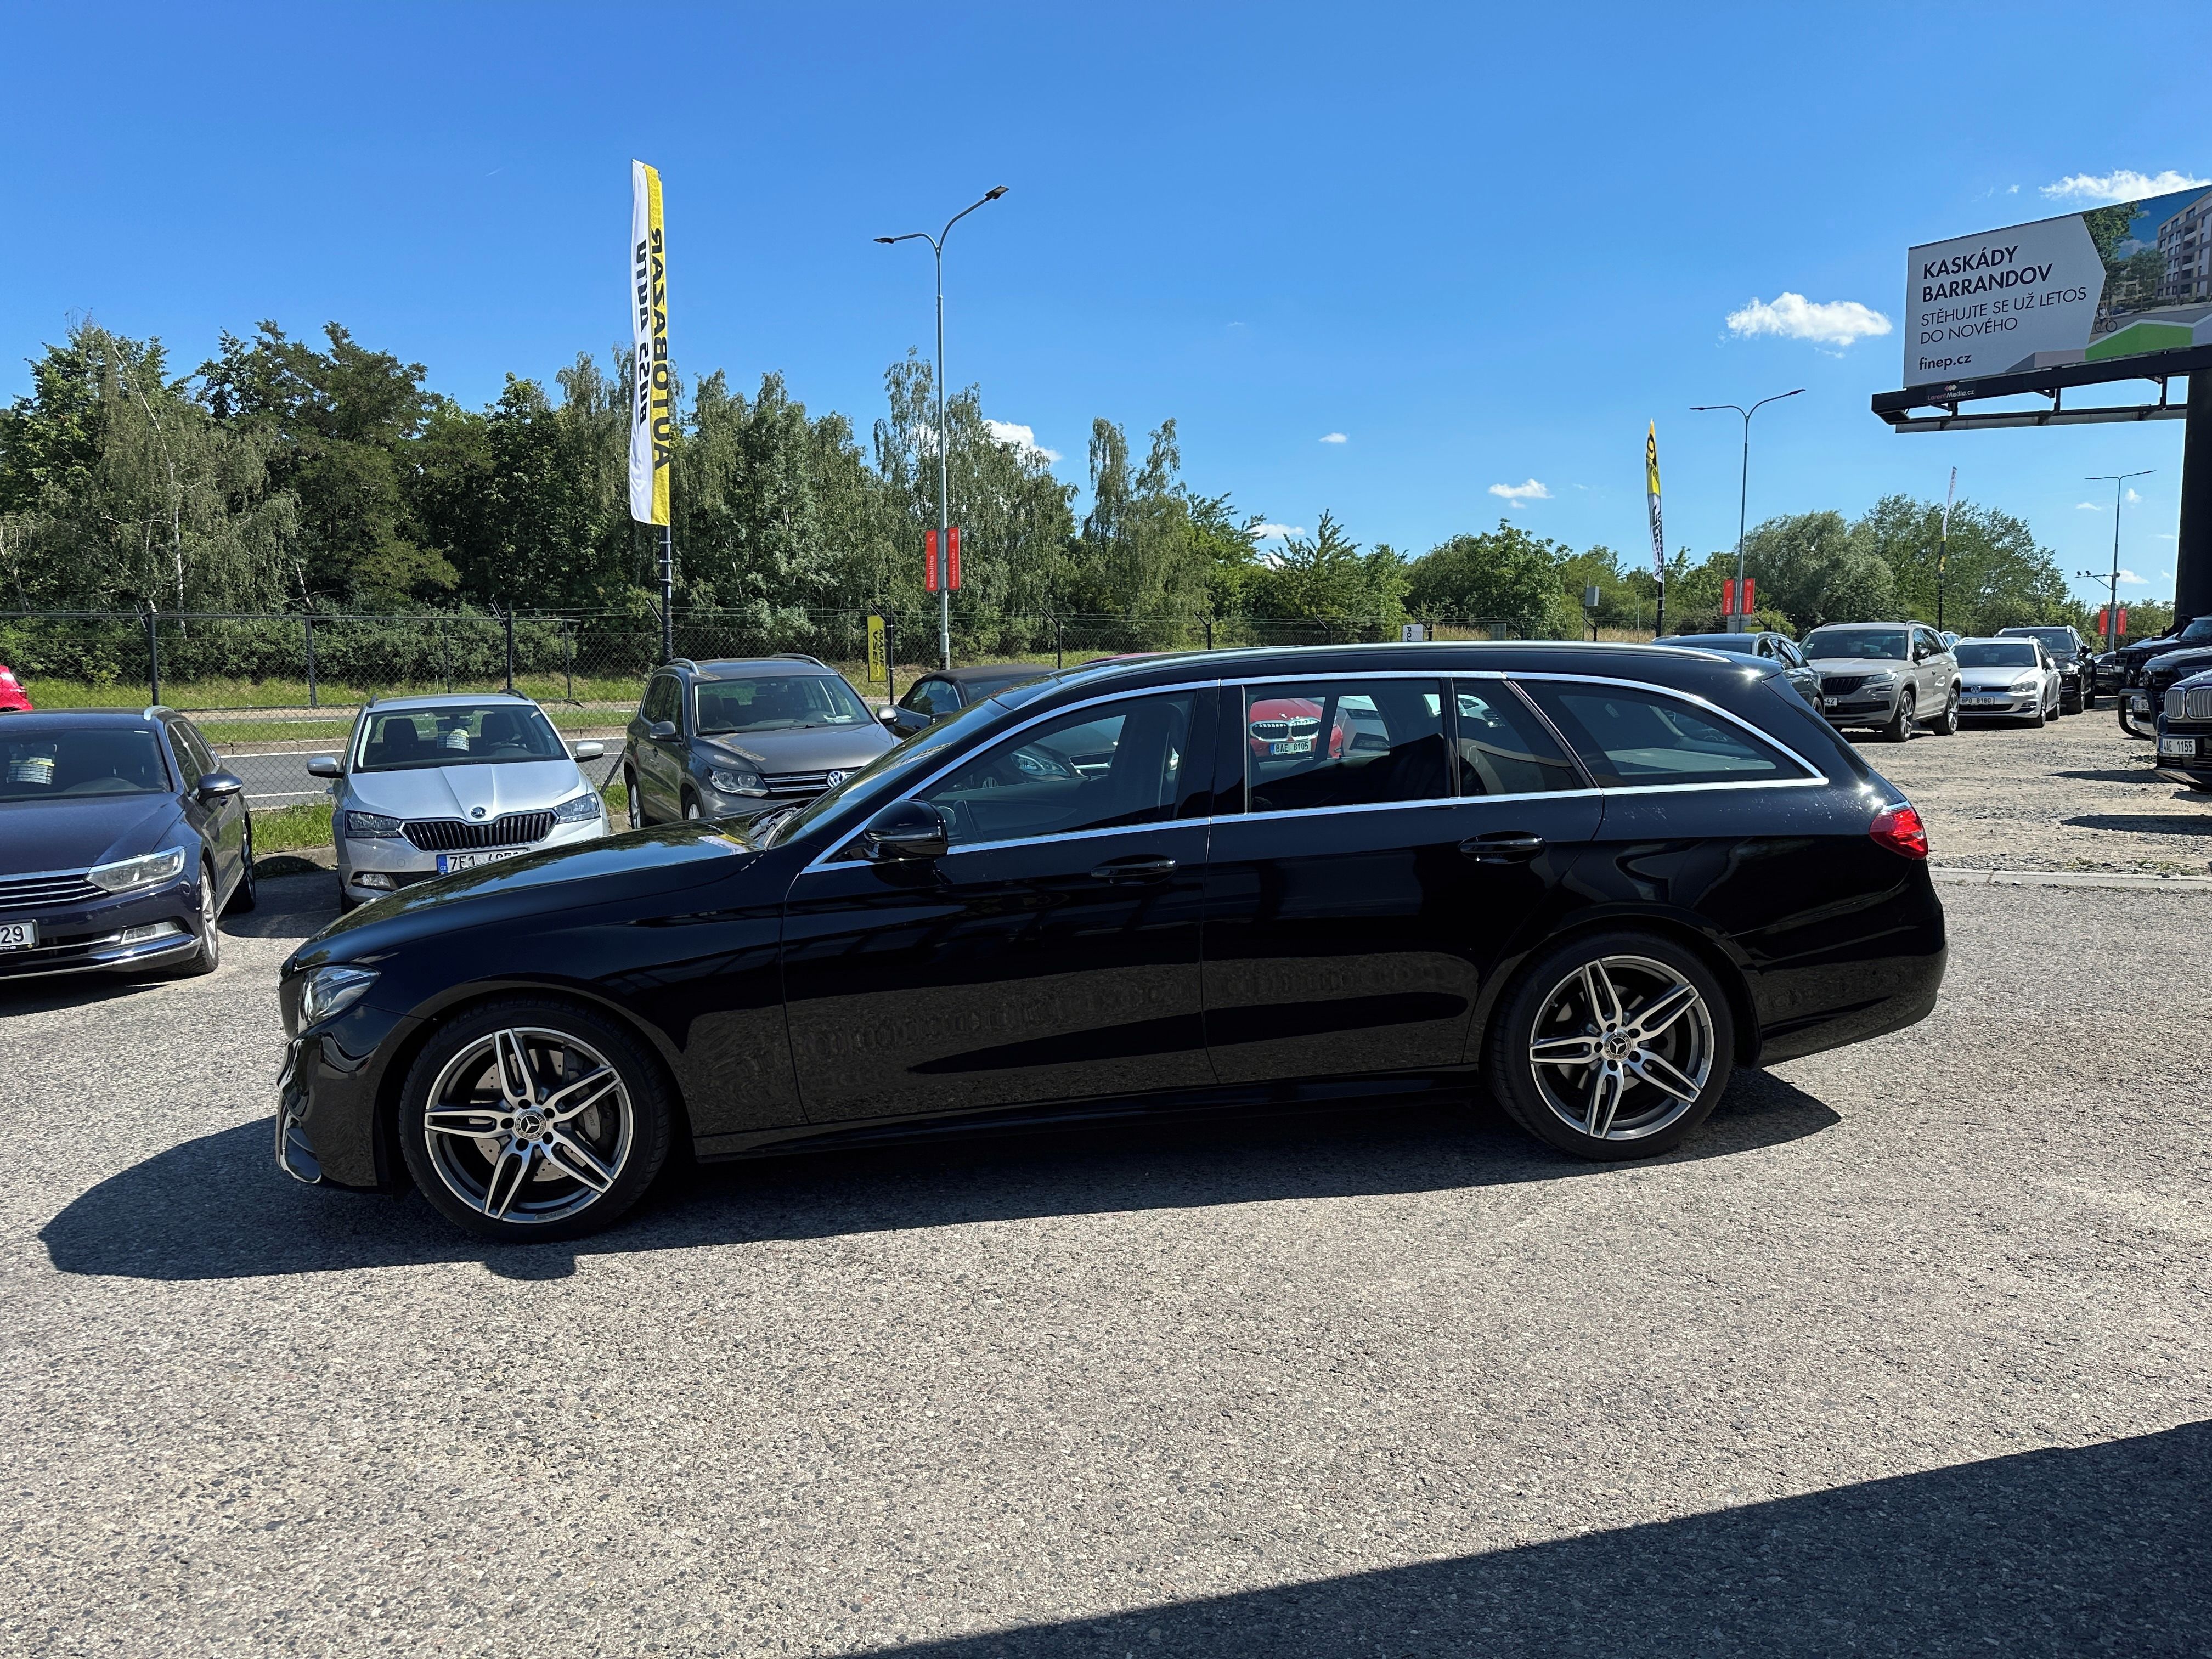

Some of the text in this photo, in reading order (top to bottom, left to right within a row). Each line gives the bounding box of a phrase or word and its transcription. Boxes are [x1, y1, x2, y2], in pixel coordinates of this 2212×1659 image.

[1923, 245, 2019, 280] KASKÁDY
[1922, 263, 2053, 303] BARRANDOV
[1921, 286, 2086, 326] STĚHUJTE SE UŽ LETOS
[1921, 317, 2018, 345] DO NOVÉHO
[1919, 354, 1972, 370] finep.cz
[1927, 390, 1974, 401] LarentMedia.cz
[1276, 742, 1309, 753] 8AE 8105
[2164, 740, 2193, 753] 4AE 1155
[450, 855, 476, 870] 7E1
[0, 926, 24, 944] 29
